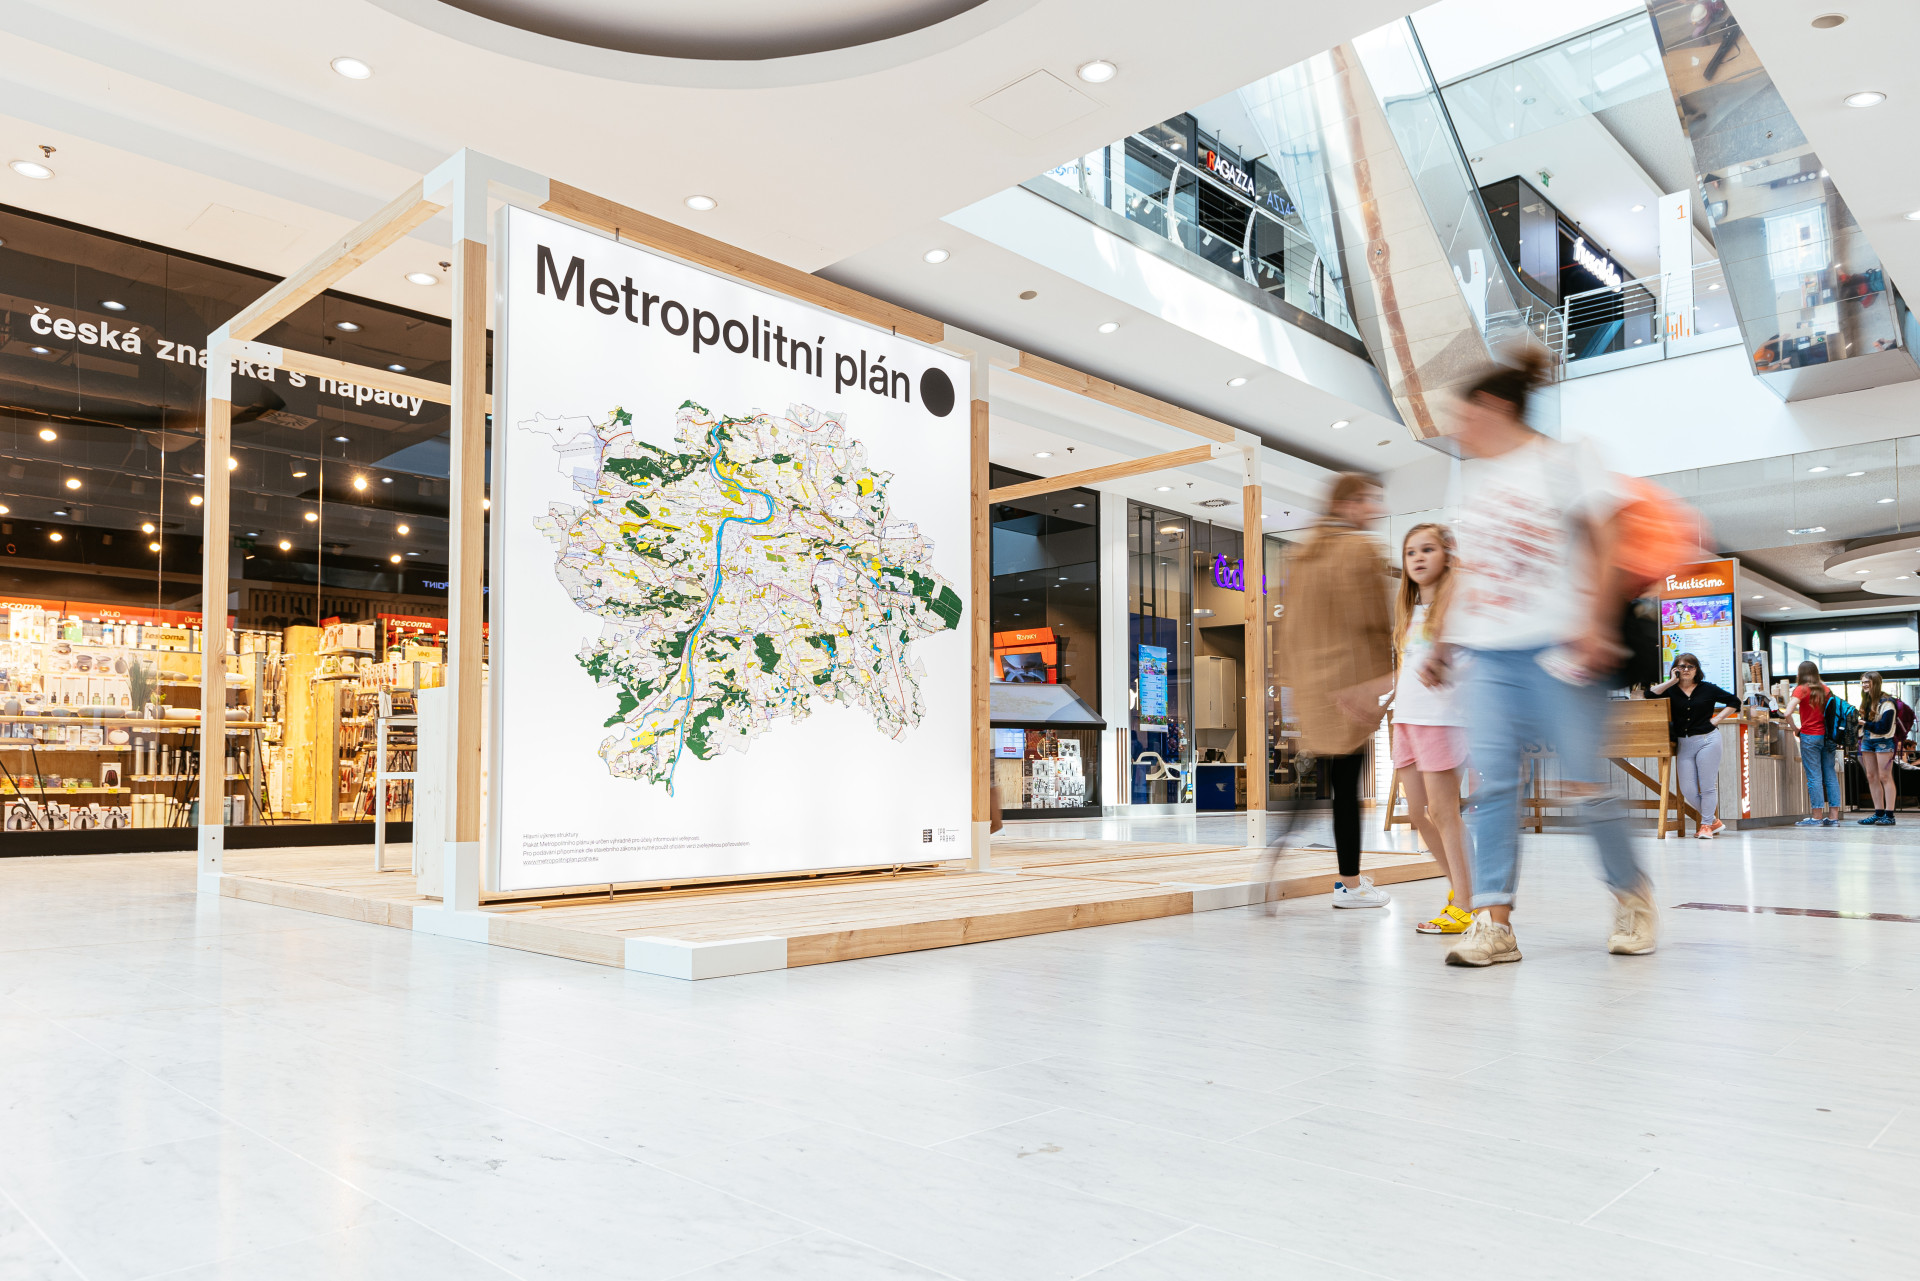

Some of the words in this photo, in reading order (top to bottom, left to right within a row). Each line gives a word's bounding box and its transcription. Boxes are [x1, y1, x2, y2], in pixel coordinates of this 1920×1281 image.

[1206, 150, 1255, 197] RAGAZZA
[1677, 204, 1687, 220] 1
[30, 305, 142, 355] česká
[156, 339, 276, 382] znaka
[288, 370, 307, 388] s
[536, 243, 825, 378] Metropolitní
[835, 349, 911, 403] plán
